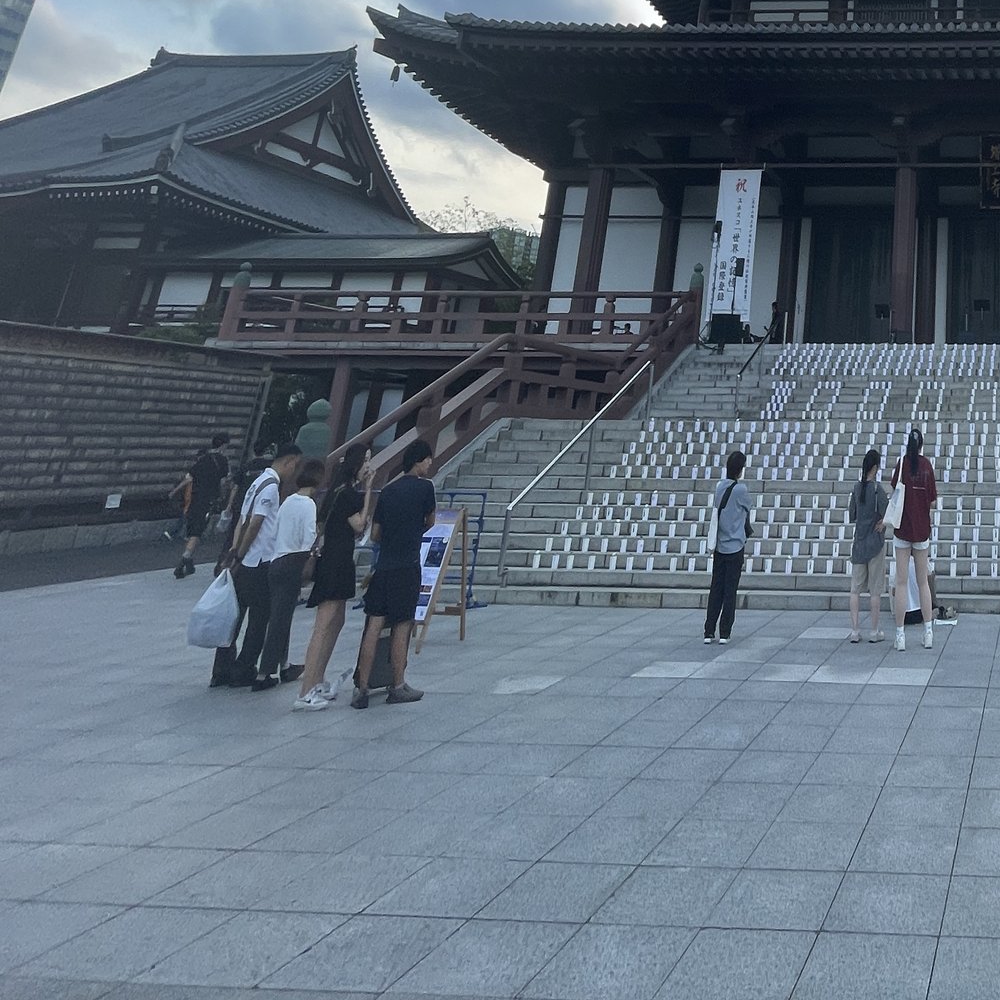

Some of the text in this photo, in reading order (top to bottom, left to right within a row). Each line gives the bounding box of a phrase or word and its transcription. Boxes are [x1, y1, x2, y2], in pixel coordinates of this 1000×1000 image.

[735, 178, 748, 193] 祝
[716, 260, 727, 302] 国際登録
